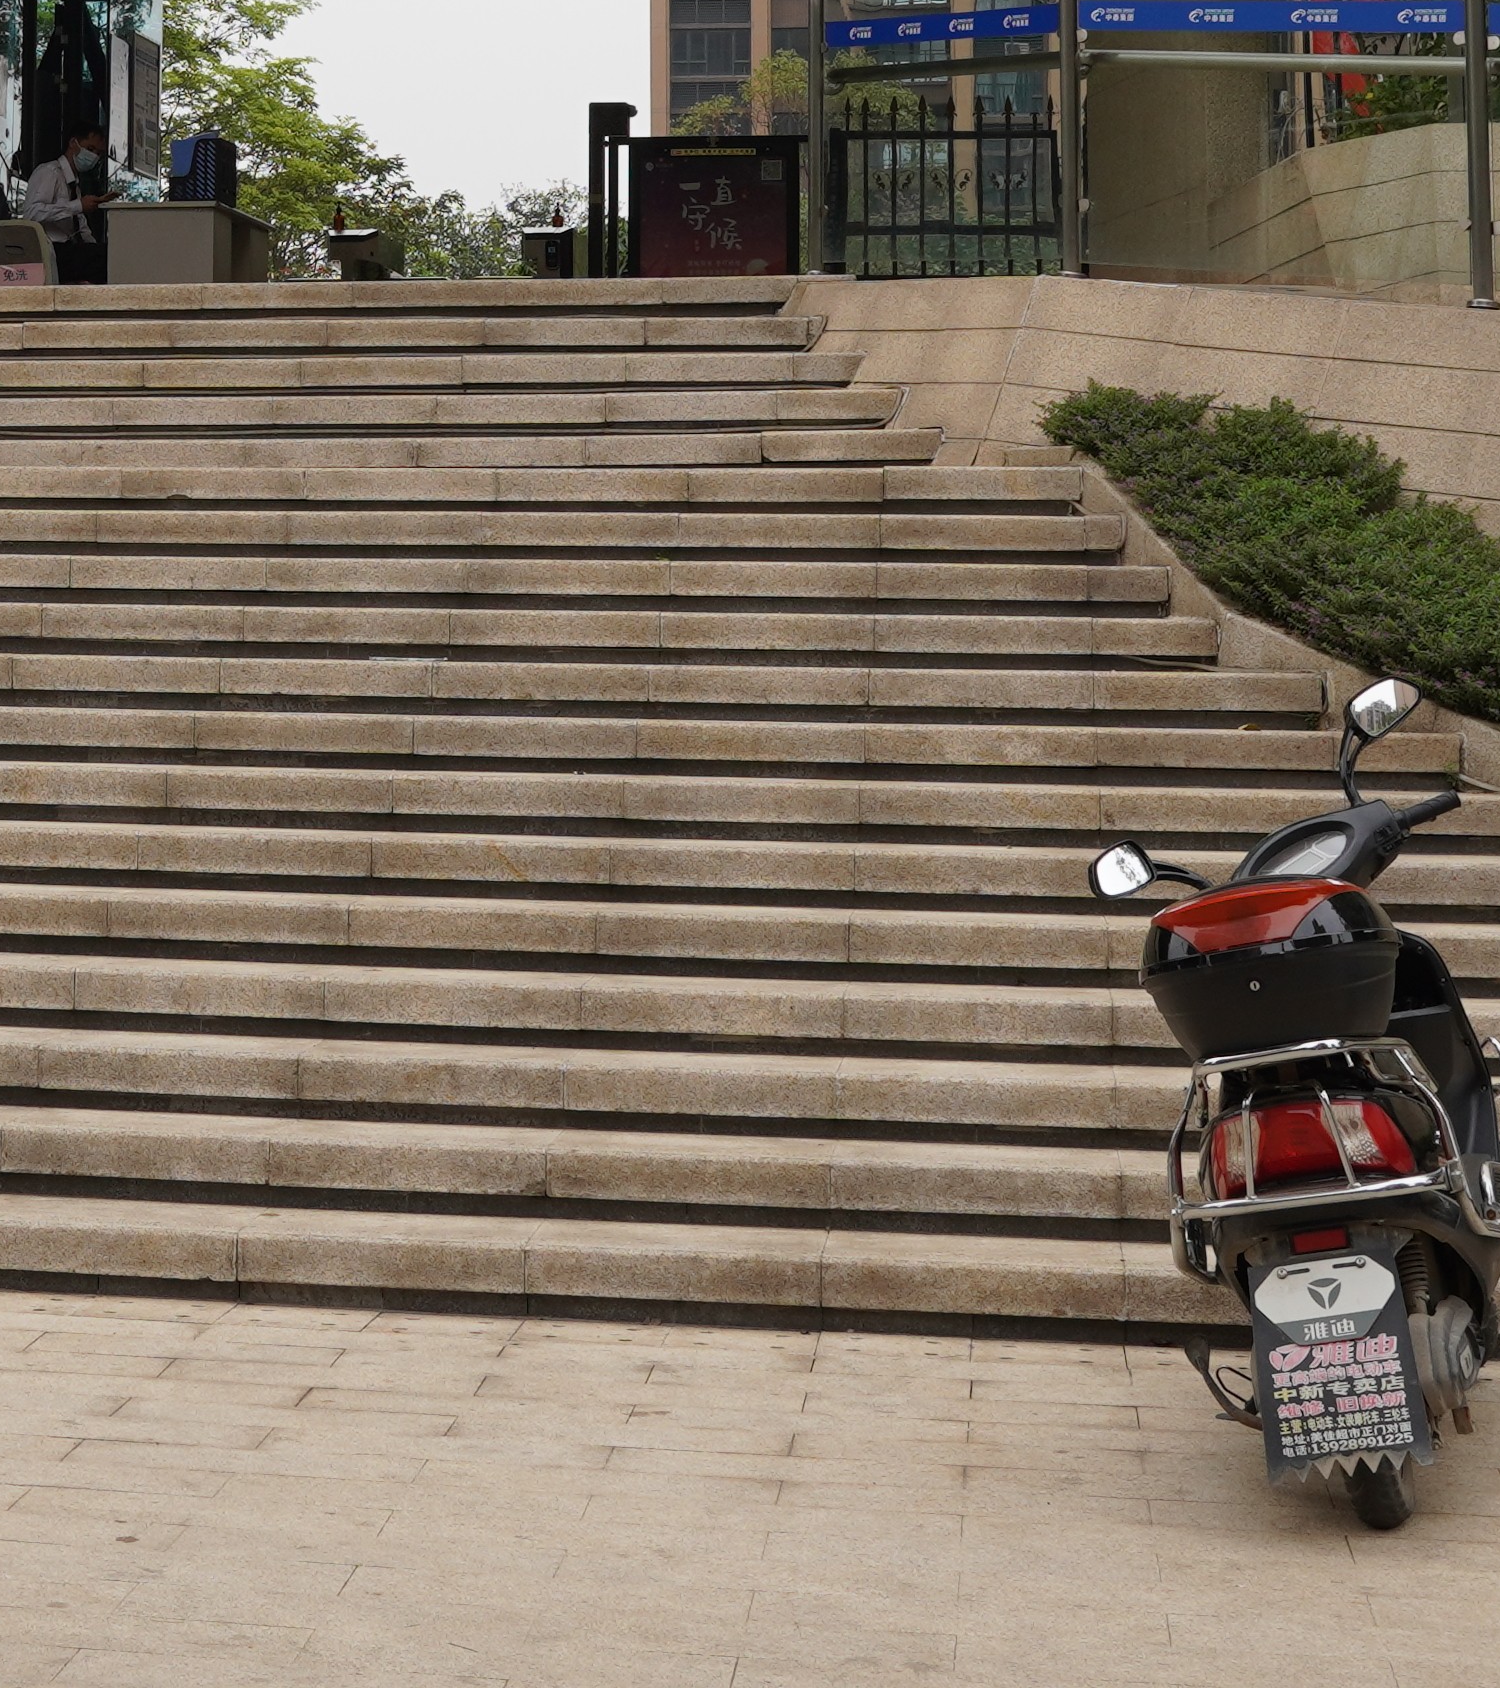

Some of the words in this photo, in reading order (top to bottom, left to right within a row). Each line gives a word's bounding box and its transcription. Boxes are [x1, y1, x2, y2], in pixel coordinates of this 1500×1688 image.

[3, 269, 28, 282] 免洗
[1303, 1318, 1357, 1341] 雅迪
[1309, 1333, 1399, 1368] 雅迪
[1274, 1375, 1405, 1402] 中新专卖店
